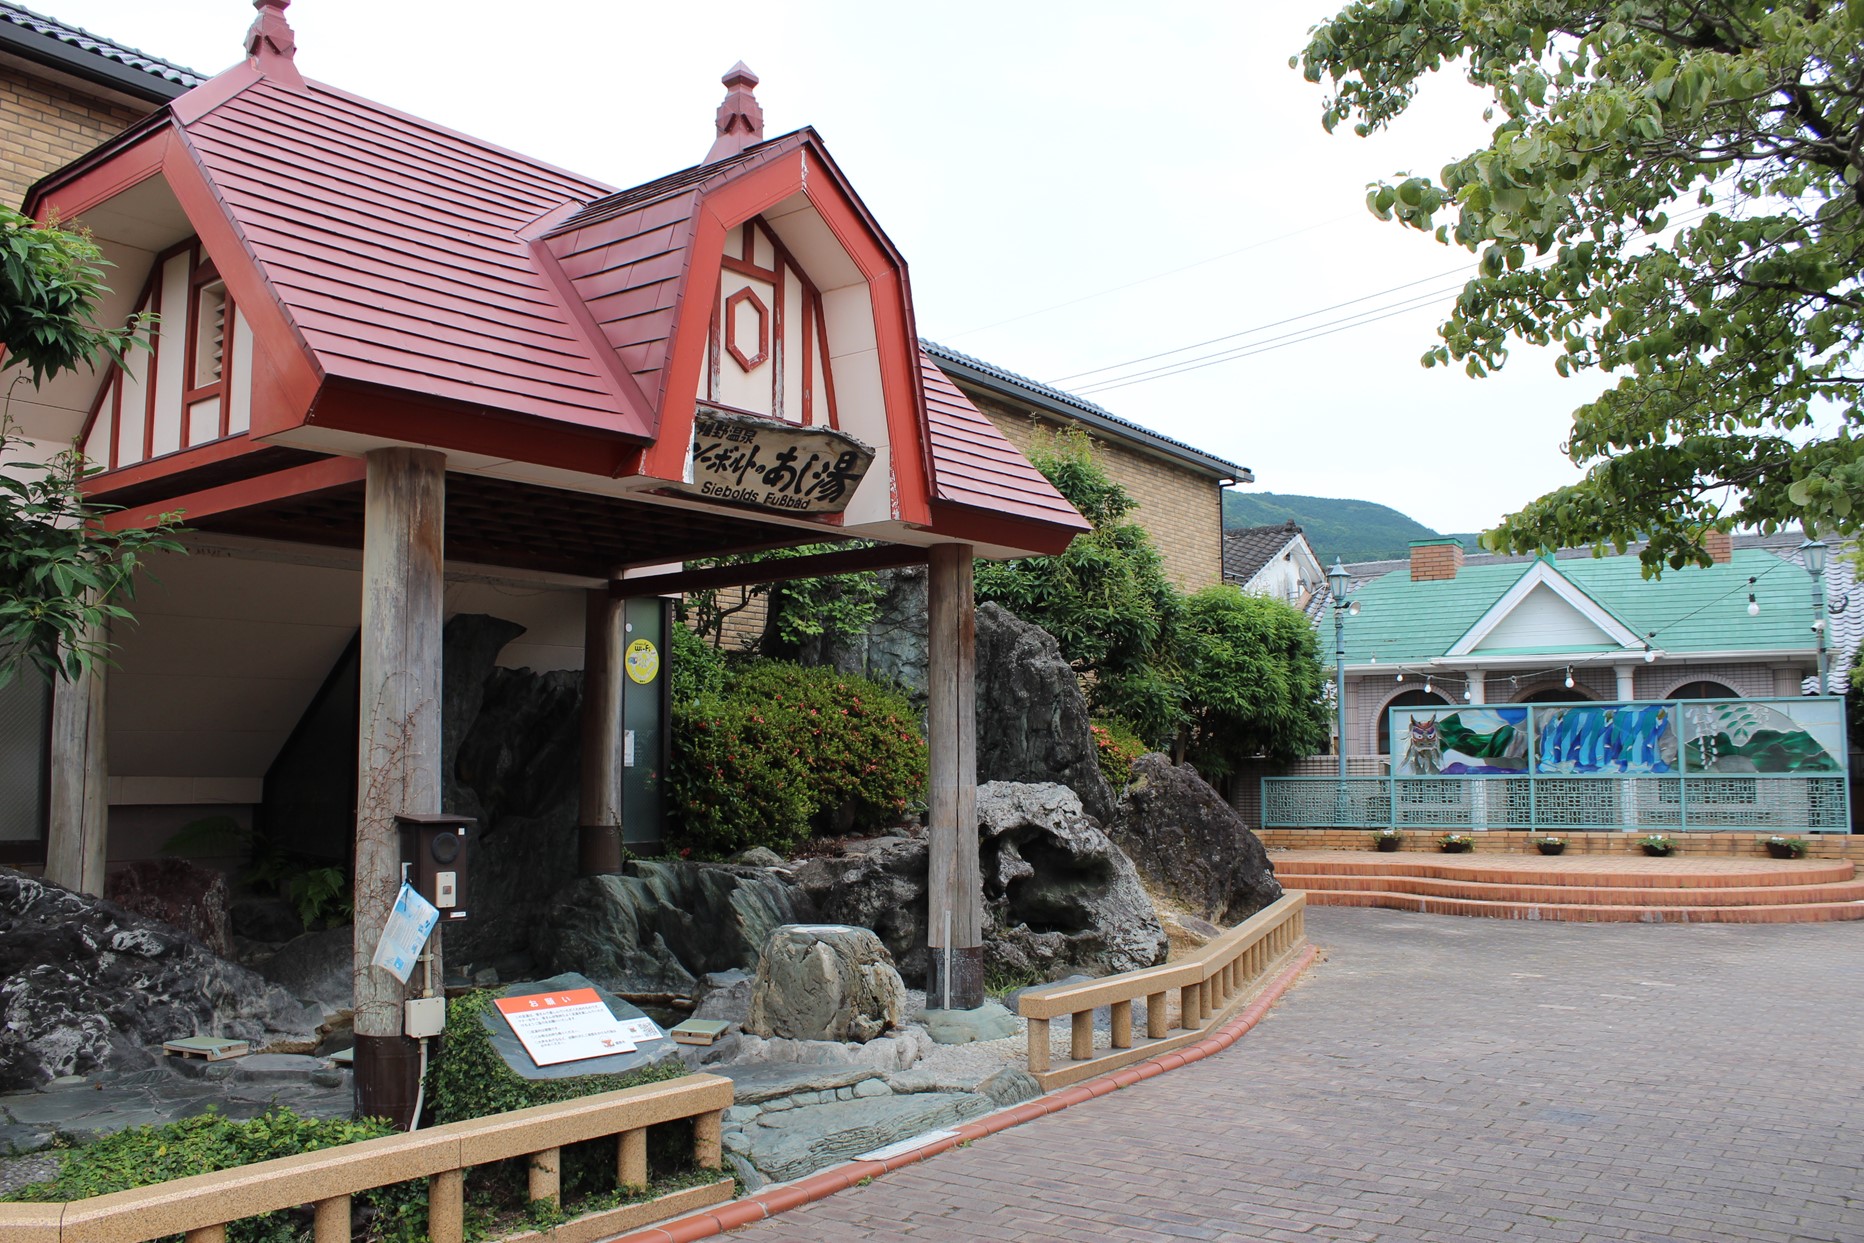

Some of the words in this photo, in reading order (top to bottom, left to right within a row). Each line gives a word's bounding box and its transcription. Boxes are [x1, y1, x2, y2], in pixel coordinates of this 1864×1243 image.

[701, 481, 759, 502] Siebolds
[528, 996, 571, 1007] お願い
